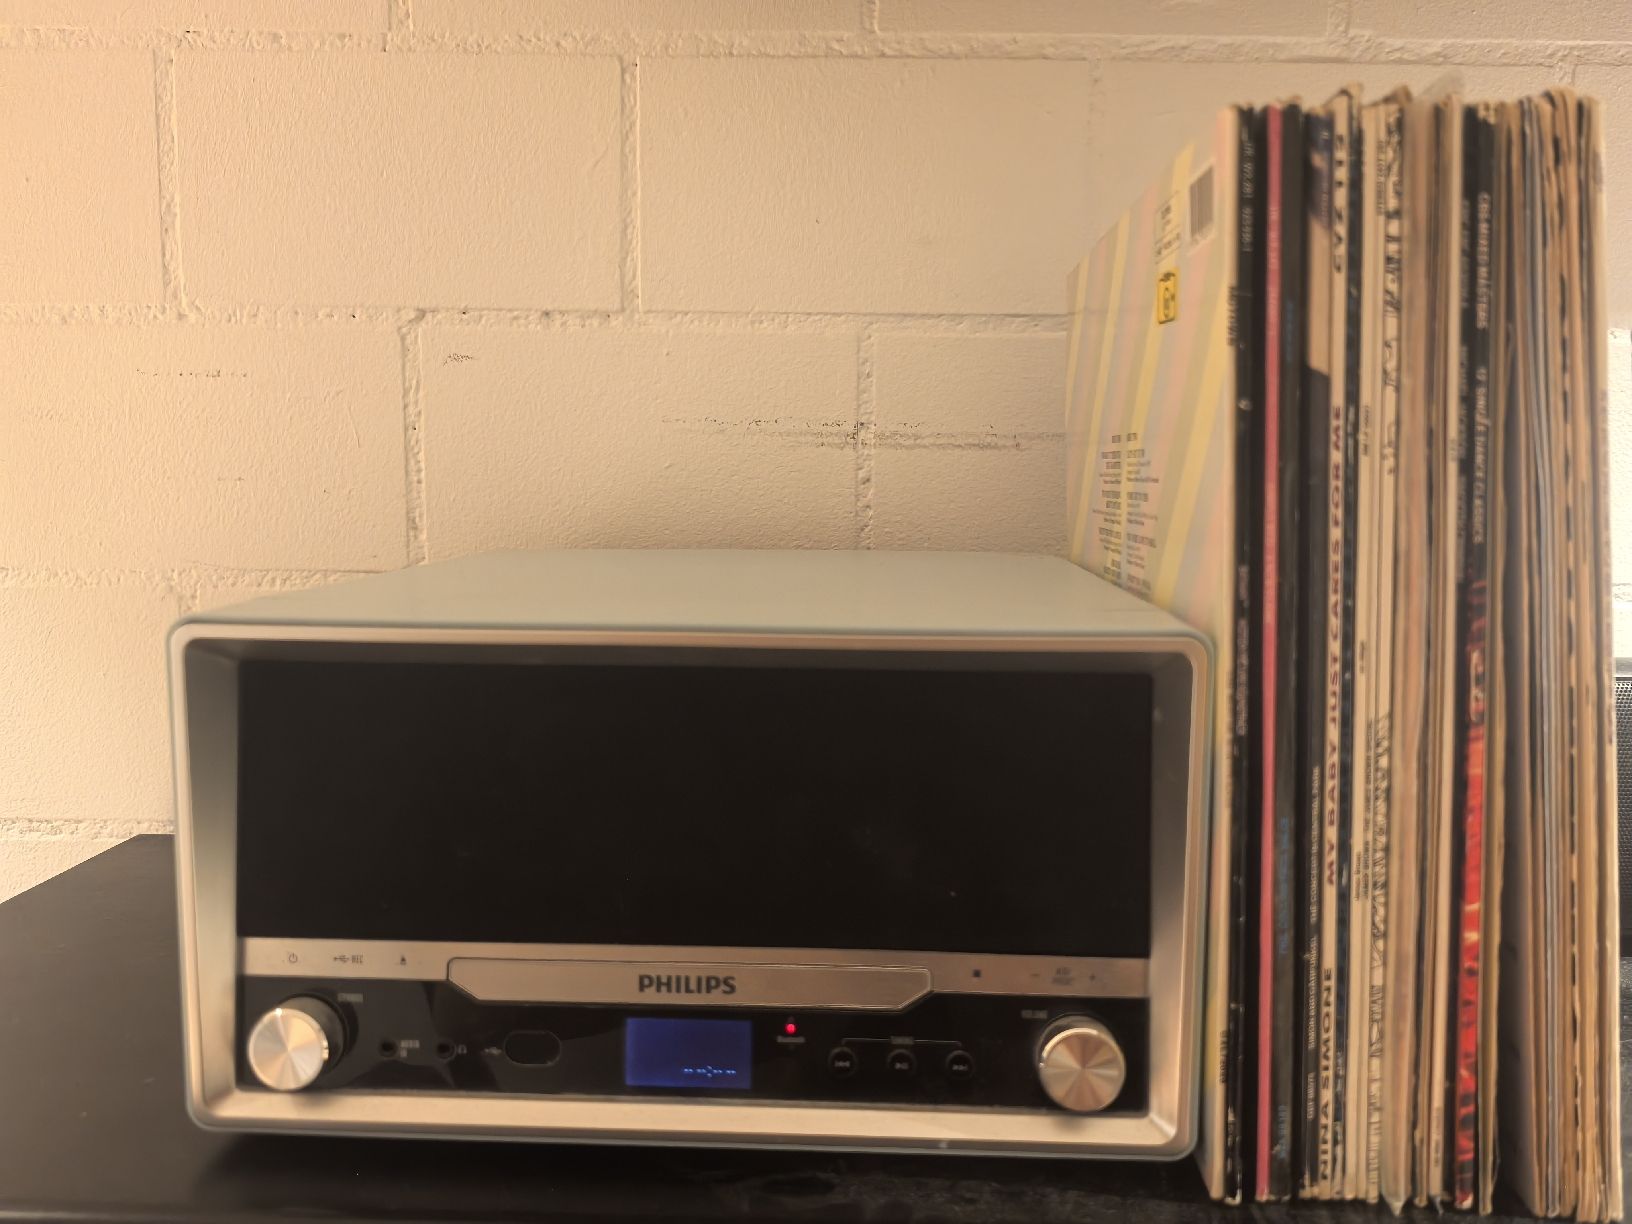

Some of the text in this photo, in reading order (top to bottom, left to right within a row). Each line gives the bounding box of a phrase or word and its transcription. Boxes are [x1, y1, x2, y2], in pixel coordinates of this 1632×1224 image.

[1477, 266, 1490, 329] MASTERS
[1473, 481, 1486, 544] CLASSICS
[1312, 766, 1322, 794] PARK
[1363, 756, 1372, 785] BROWN
[1319, 406, 1342, 1181] NINA SIMONE MY BABY JUST CARES FOR ME
[1311, 796, 1321, 843] CENTRAL
[1362, 840, 1370, 871] BROWN
[1310, 856, 1320, 903] CONCERT
[1361, 873, 1370, 900] JAMES
[1309, 904, 1319, 924] THE
[1308, 935, 1319, 996] GARFUNKEL
[638, 974, 737, 995] PHILIPS
[1308, 997, 1317, 1016] AND
[1307, 1017, 1316, 1050] SIMON
